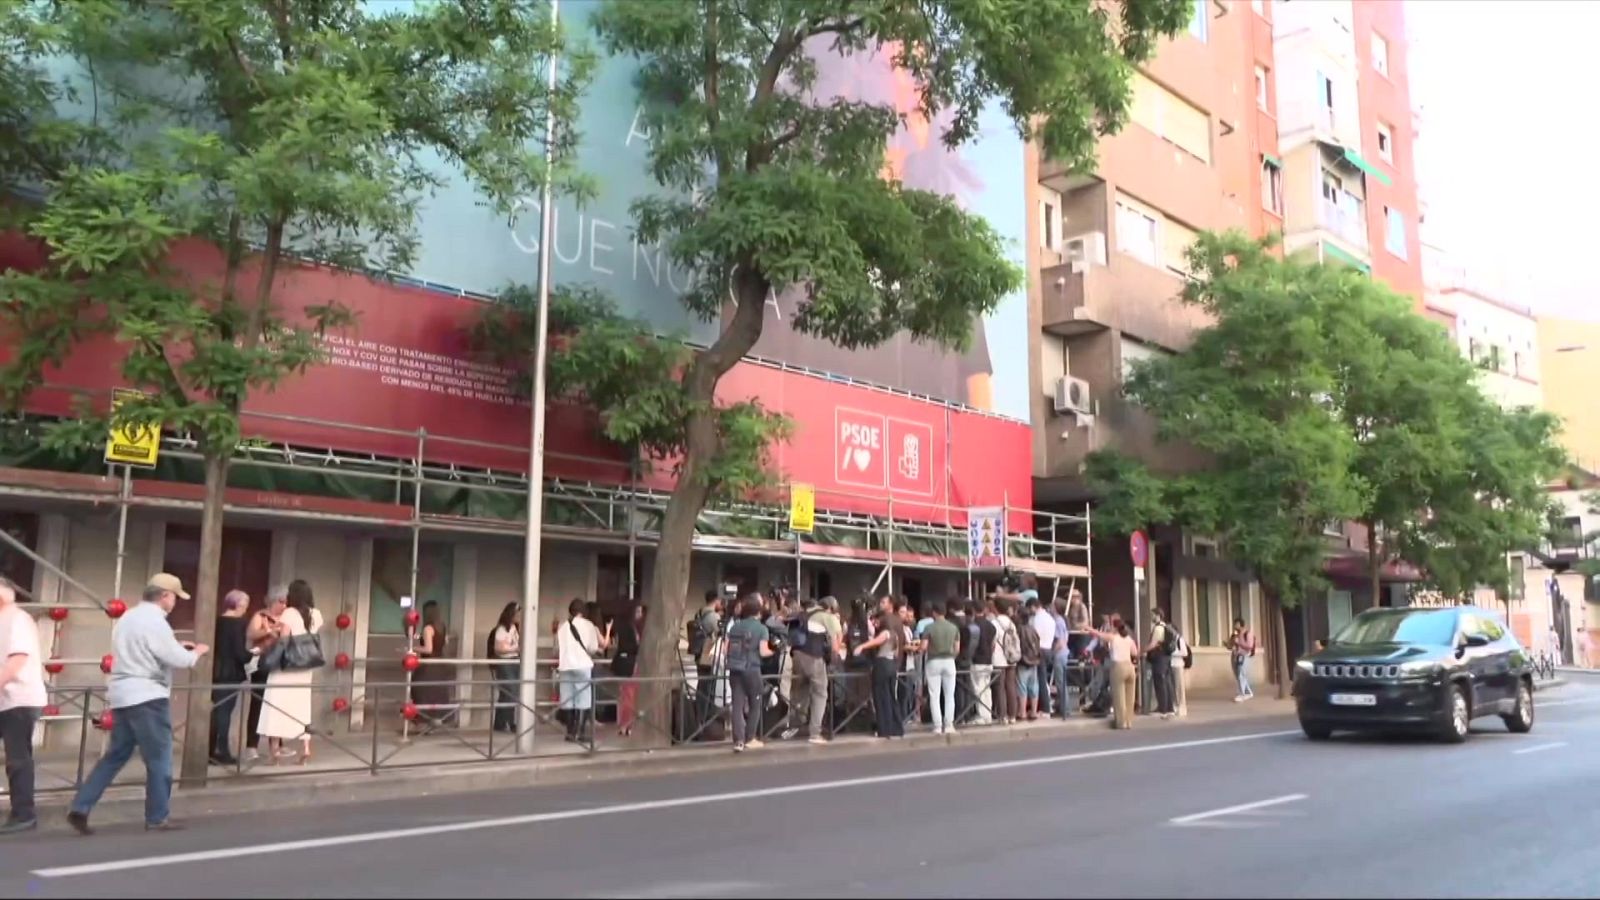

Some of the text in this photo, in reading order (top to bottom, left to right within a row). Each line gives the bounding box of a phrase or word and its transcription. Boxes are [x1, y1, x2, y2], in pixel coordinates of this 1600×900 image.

[510, 198, 616, 276] QUE
[331, 346, 351, 357] NOX
[352, 349, 359, 359] Y
[360, 351, 378, 361] COV
[379, 354, 397, 364] QUE
[398, 357, 426, 370] PASAN
[426, 362, 453, 375] SOBRE
[454, 369, 466, 377] LA
[358, 339, 377, 351] AIRE
[379, 343, 398, 355] CON
[400, 348, 453, 364] TRATAMIENTO
[379, 364, 421, 379] DERIVADO
[381, 375, 399, 385] CON
[400, 378, 429, 391] MENOS
[430, 384, 445, 393] DEL
[841, 421, 881, 449] PSOE
